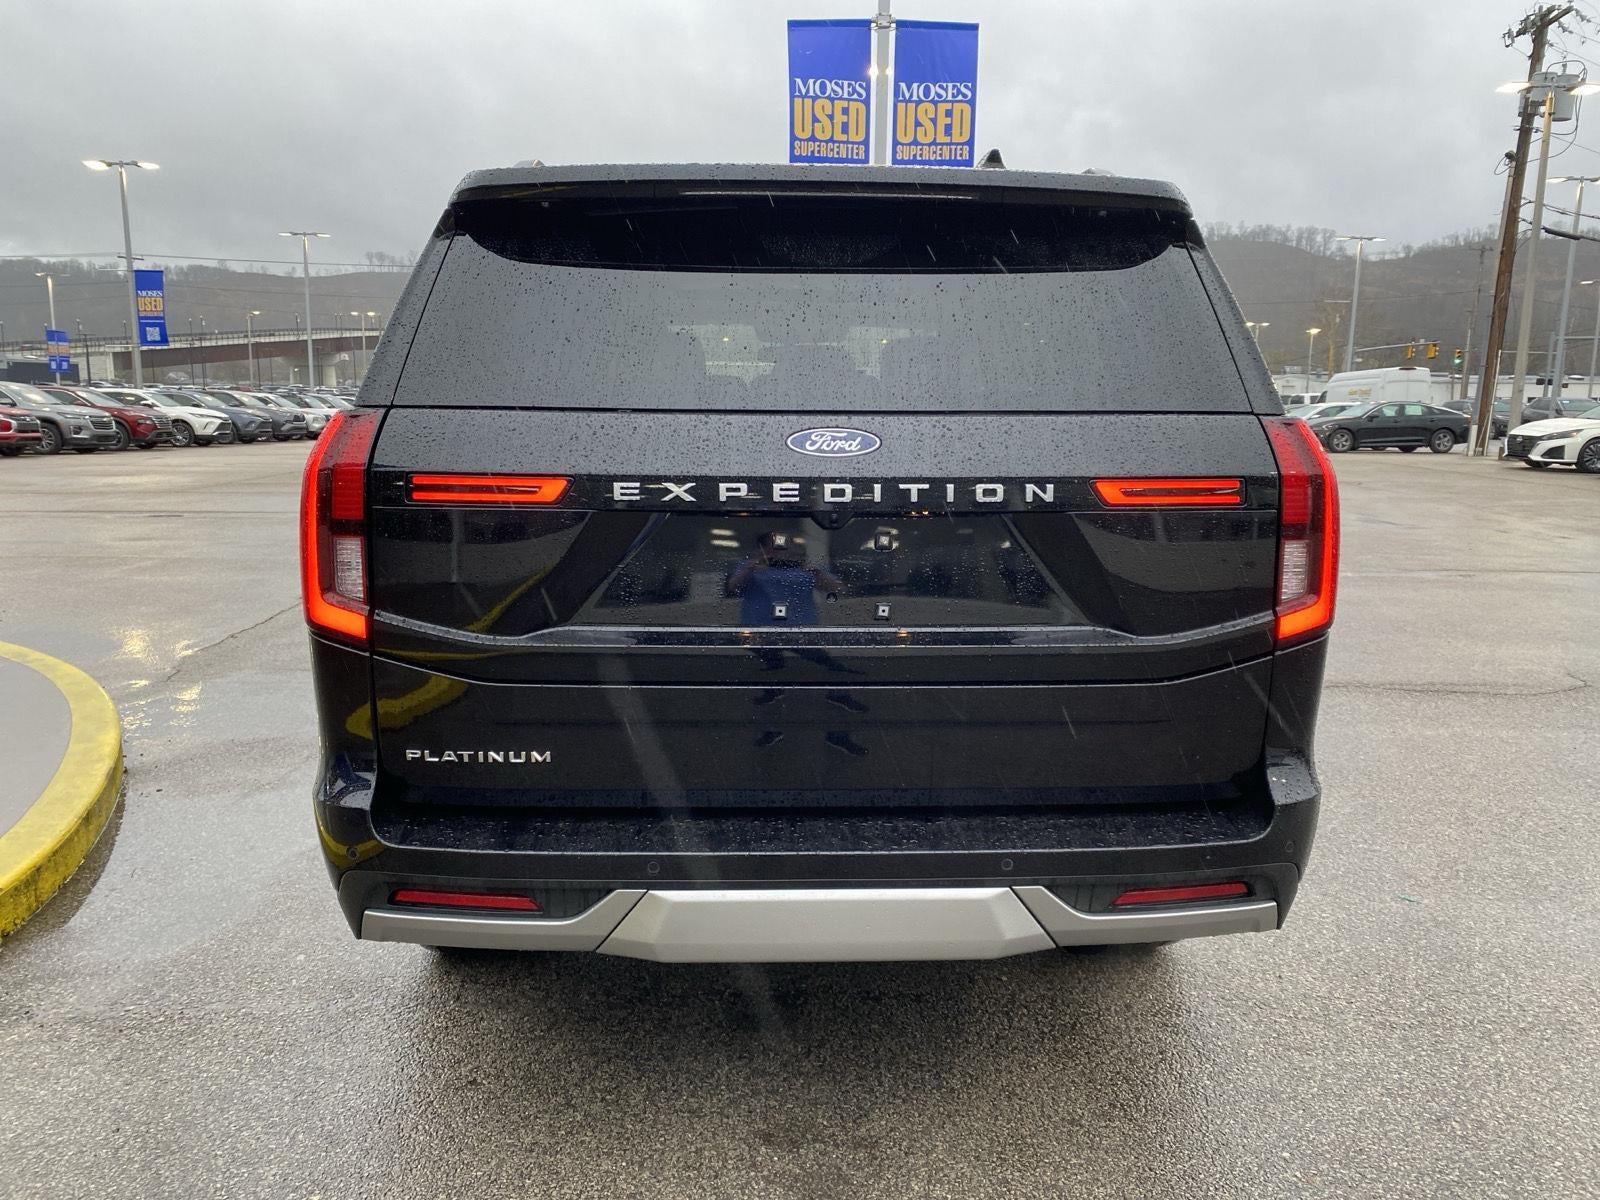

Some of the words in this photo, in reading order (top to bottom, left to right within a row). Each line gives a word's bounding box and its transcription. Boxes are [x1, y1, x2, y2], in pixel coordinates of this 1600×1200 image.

[794, 78, 866, 99] MOSES
[898, 82, 972, 101] MOSES
[793, 97, 866, 142] USED
[896, 102, 971, 143] USED
[794, 141, 865, 160] SUPERCENTER
[896, 144, 969, 160] SUPERCENTER
[138, 297, 163, 311] USED
[805, 431, 861, 451] Ford
[612, 481, 1055, 503] EXPEDITION
[405, 749, 552, 763] PLATINUM
